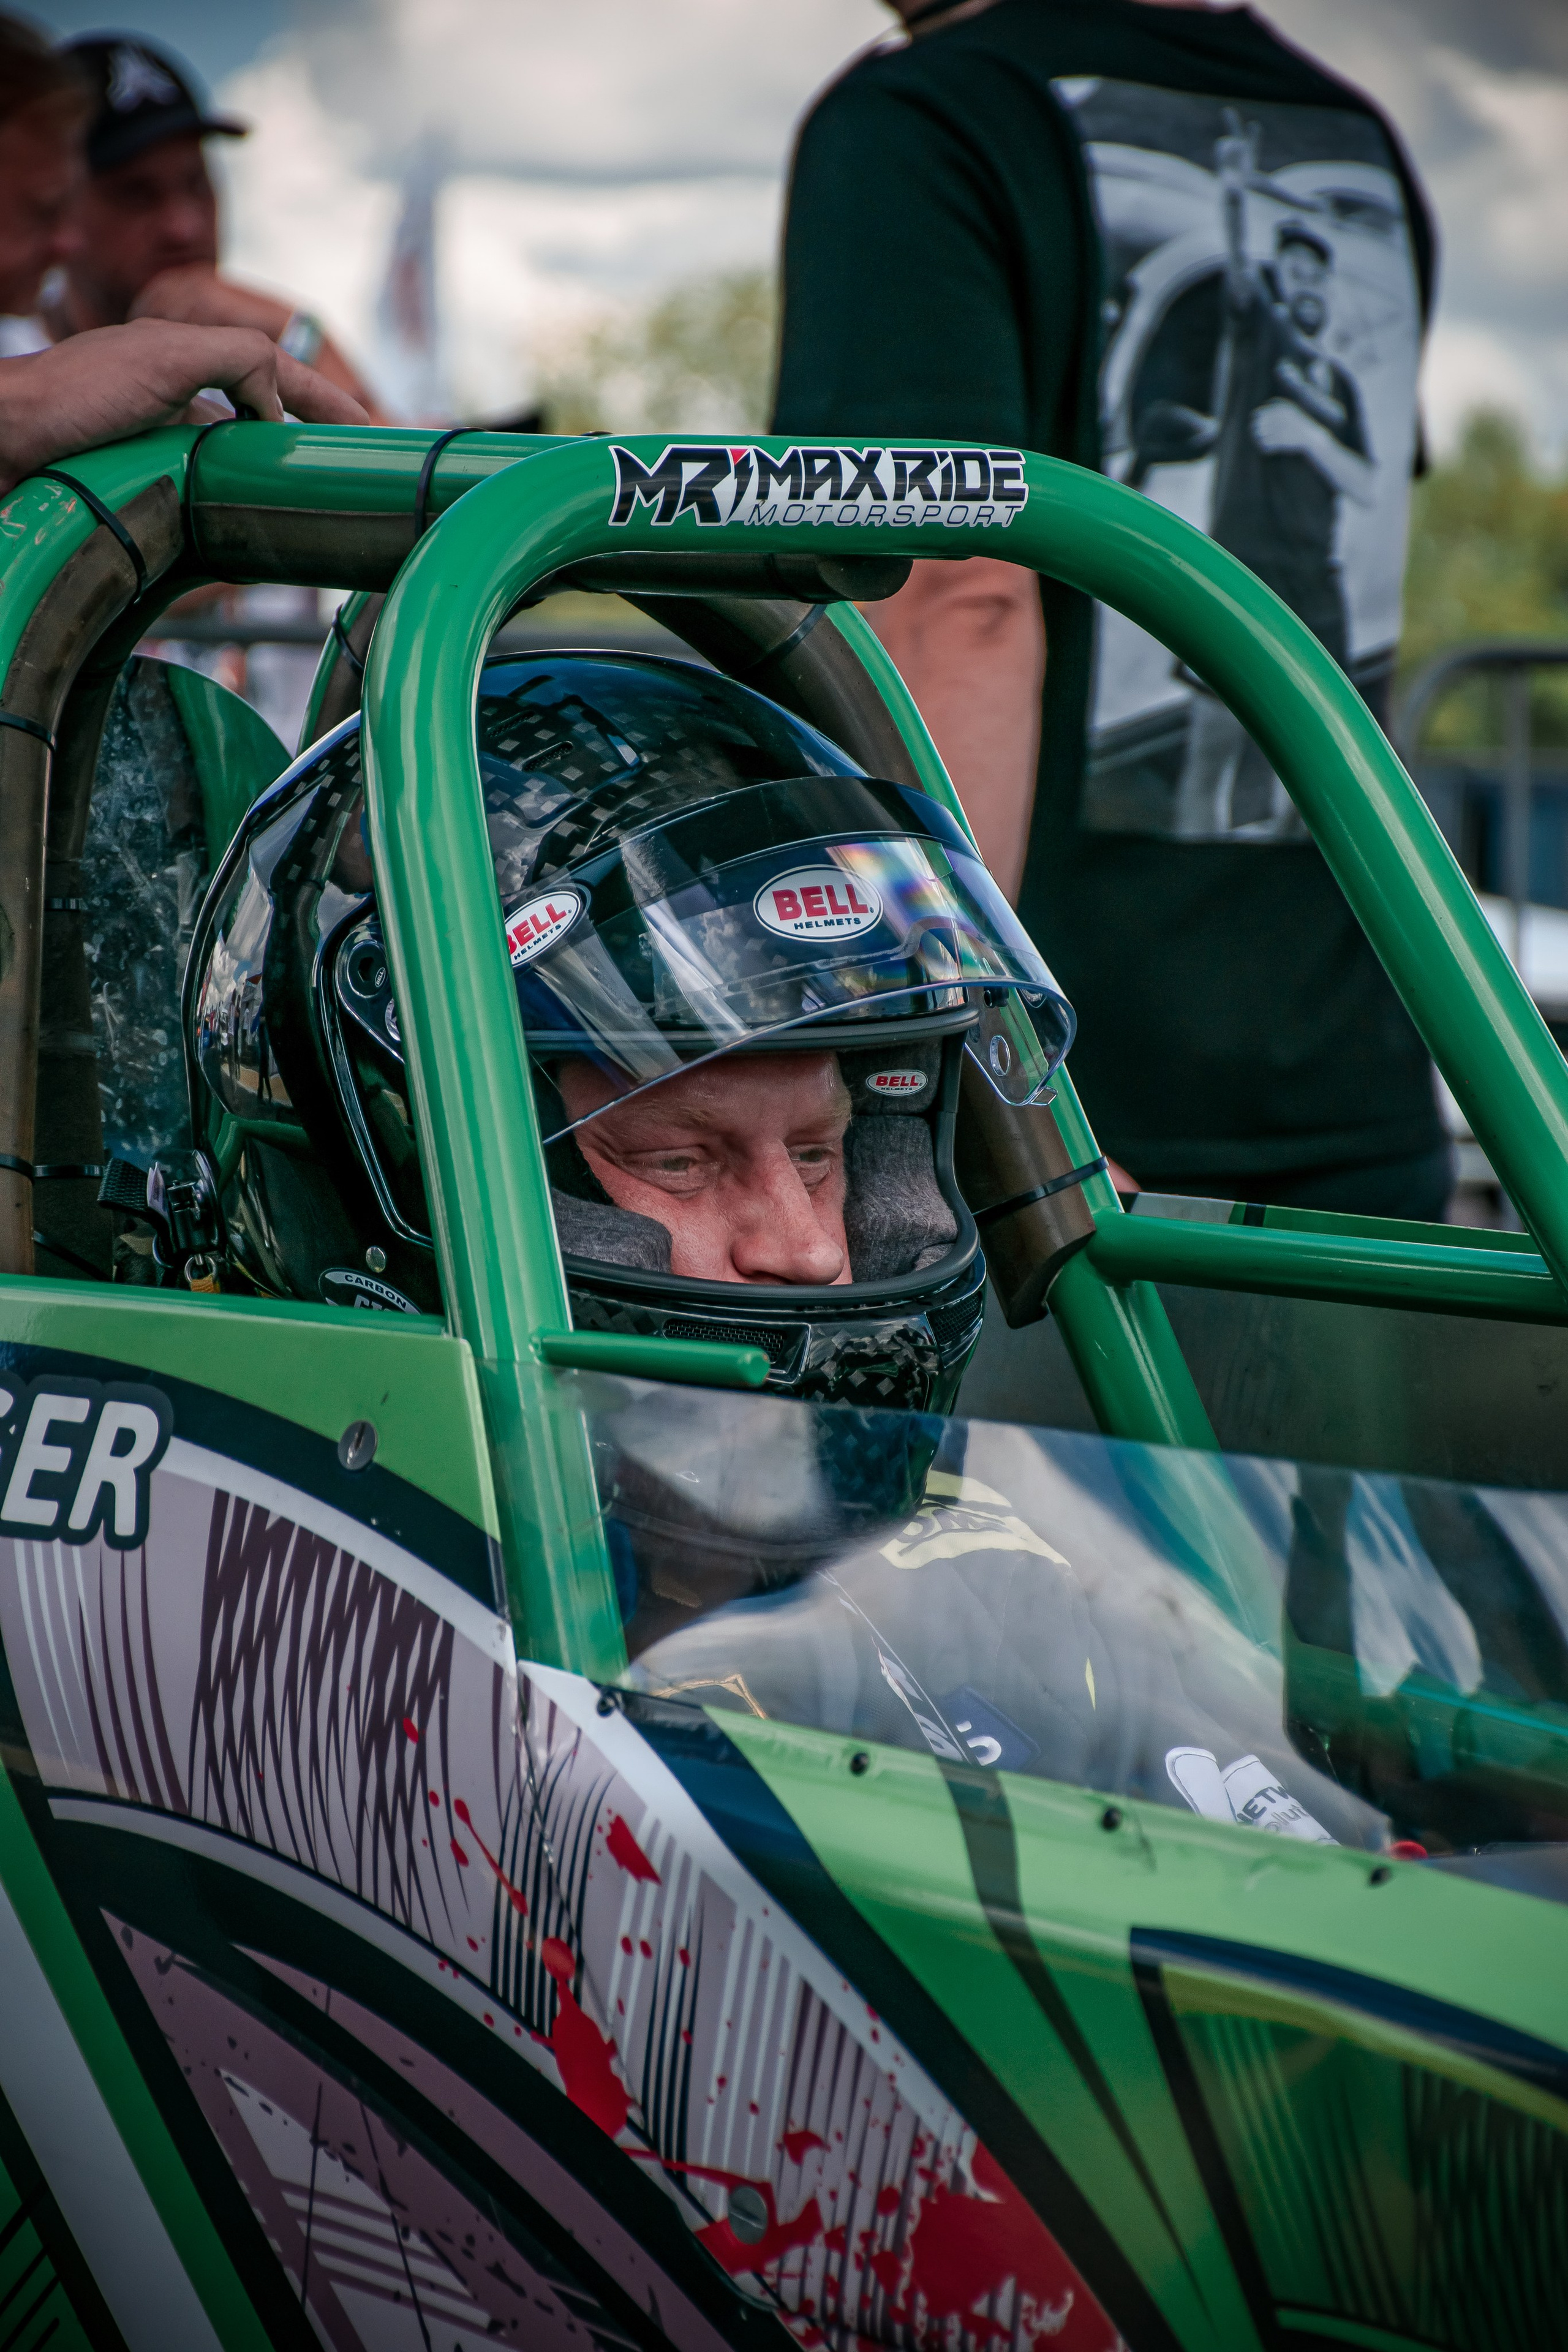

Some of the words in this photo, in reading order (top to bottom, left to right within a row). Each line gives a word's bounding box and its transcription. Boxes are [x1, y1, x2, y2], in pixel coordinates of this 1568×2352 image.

[753, 504, 1023, 526] MOTORSPORT
[772, 883, 869, 921] BELL
[794, 918, 862, 930] HELMETS
[514, 924, 562, 960] HELMETS
[875, 1075, 919, 1087] BELL
[344, 1275, 407, 1310] CARBON
[0, 1387, 159, 1536] ER
